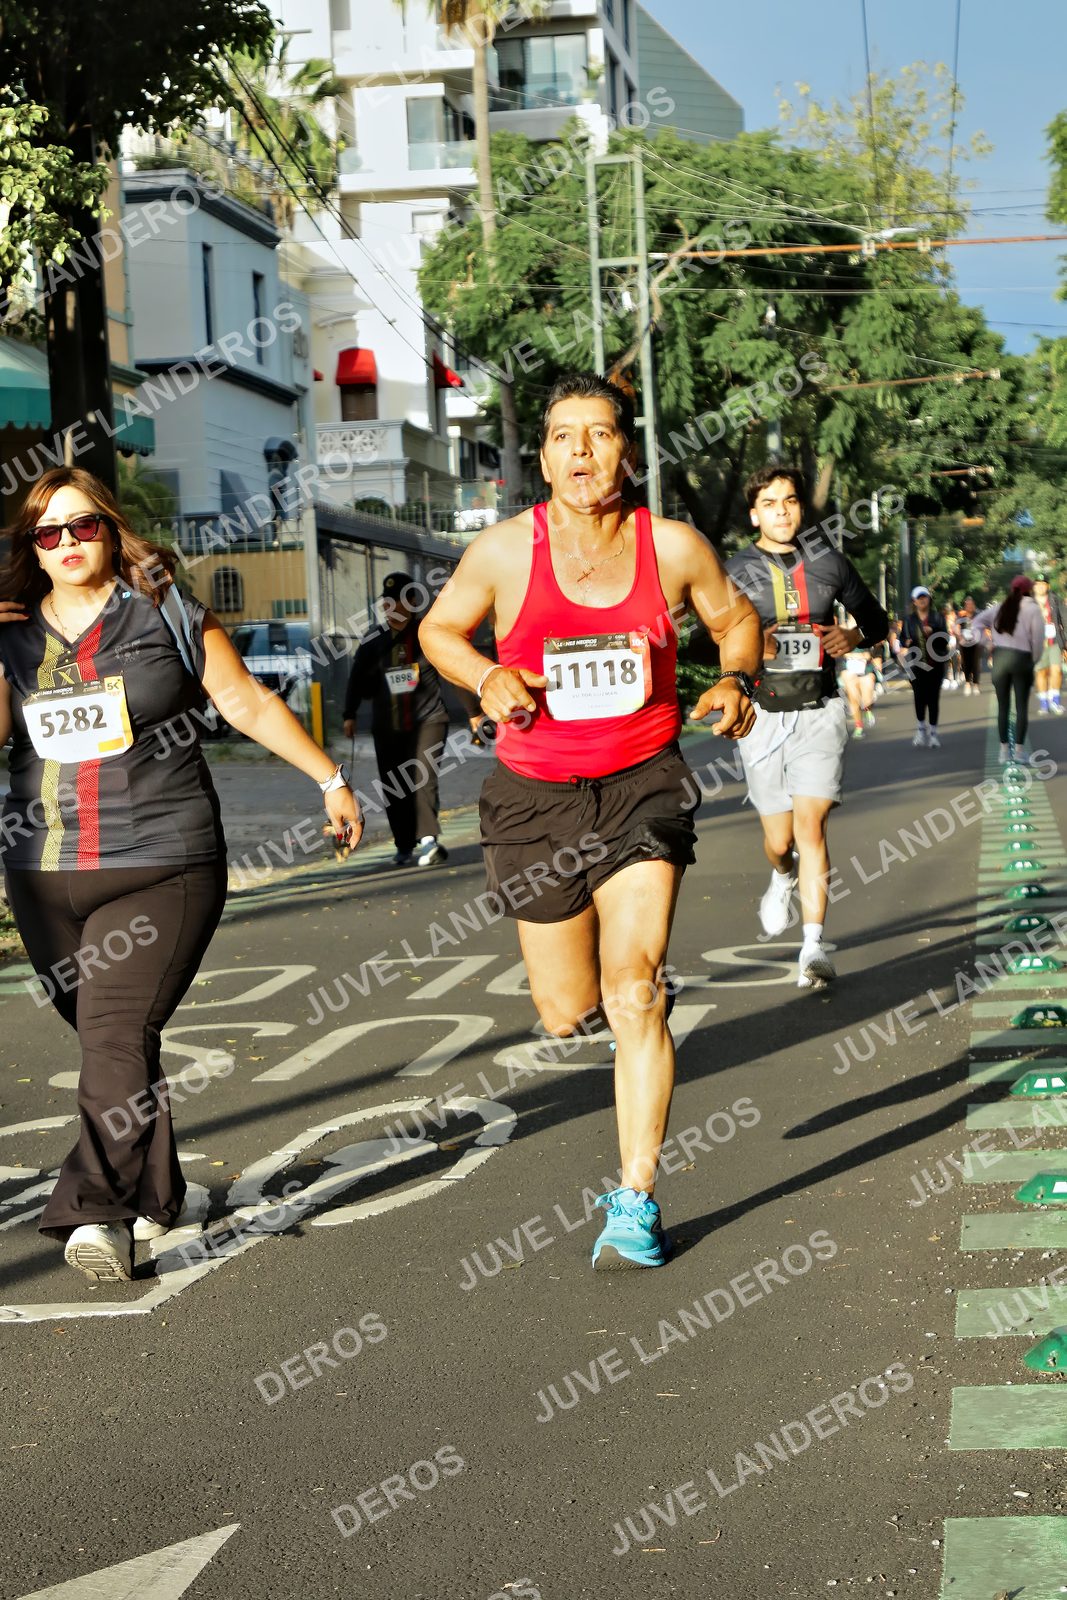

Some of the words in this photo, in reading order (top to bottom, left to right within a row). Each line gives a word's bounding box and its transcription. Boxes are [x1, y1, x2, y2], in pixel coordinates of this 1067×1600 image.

[632, 639, 645, 647] 10K
[389, 672, 412, 684] 1898
[550, 659, 637, 690] 11118
[40, 704, 107, 738] 5282
